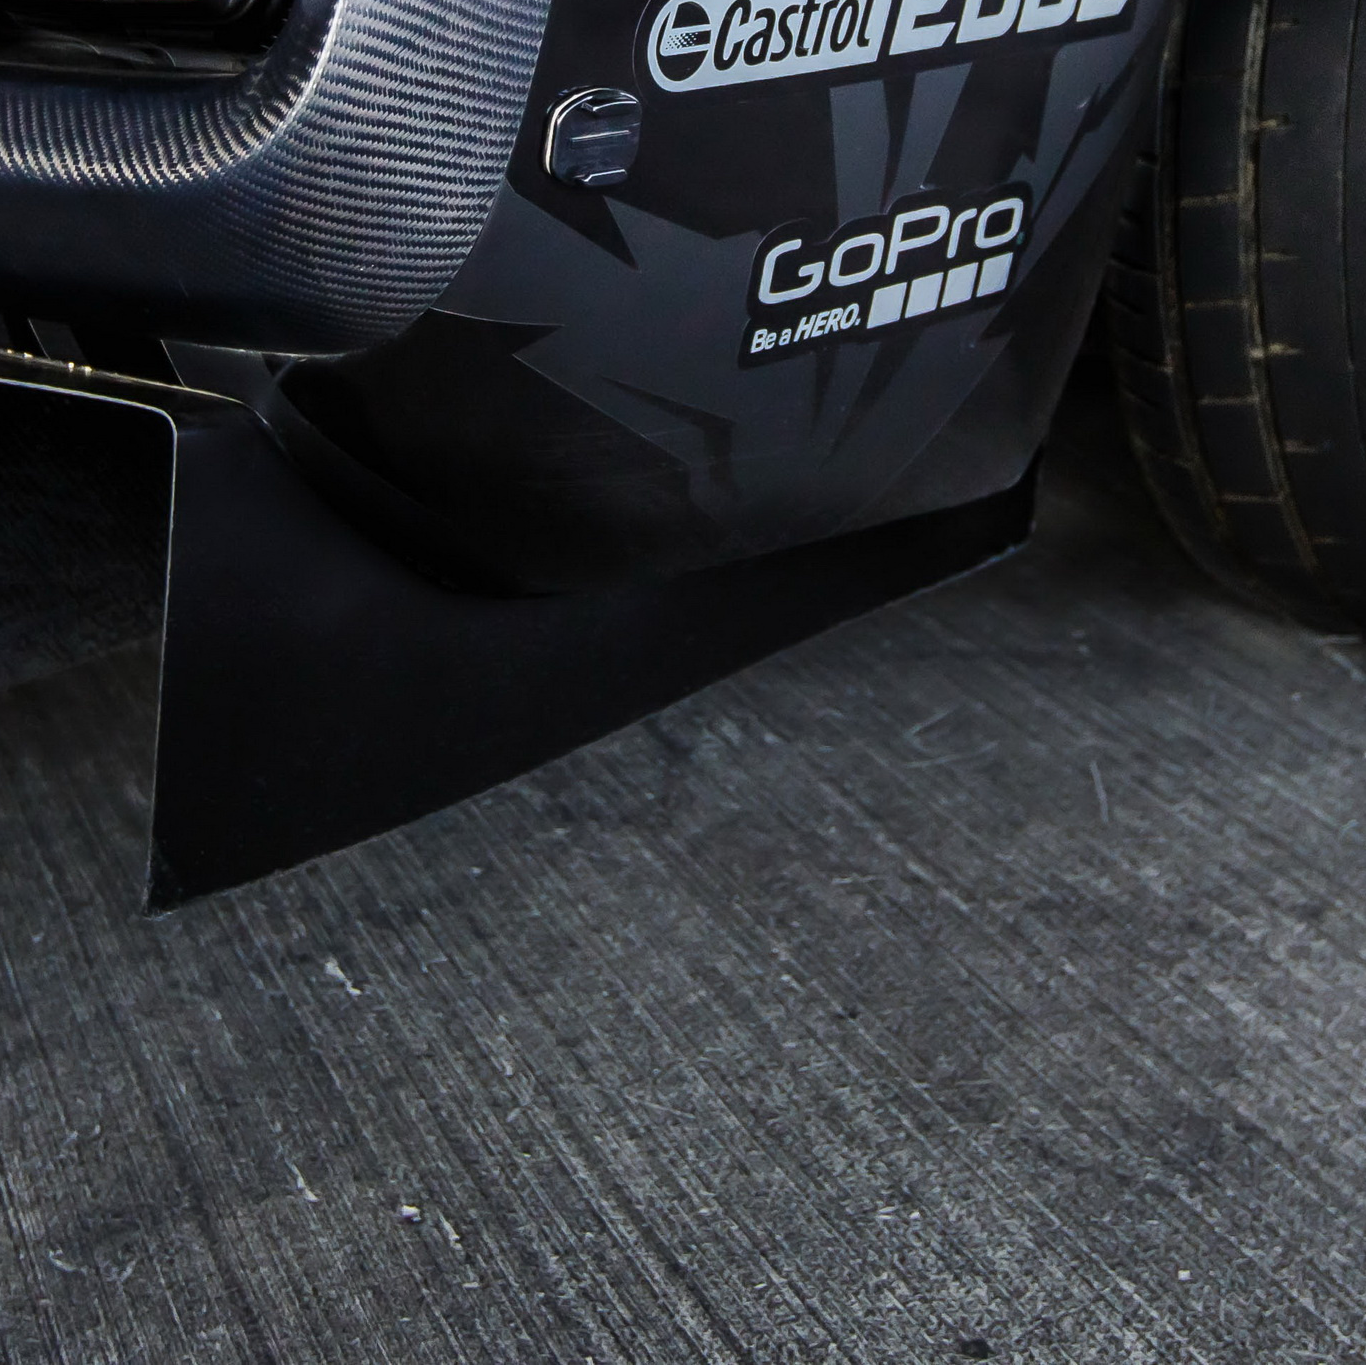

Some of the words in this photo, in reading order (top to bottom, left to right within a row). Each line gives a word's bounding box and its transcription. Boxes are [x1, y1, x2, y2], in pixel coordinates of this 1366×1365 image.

[758, 196, 1024, 305] GoPro
[750, 328, 777, 354] Be
[778, 328, 793, 347] a
[793, 302, 862, 343] HERO.
